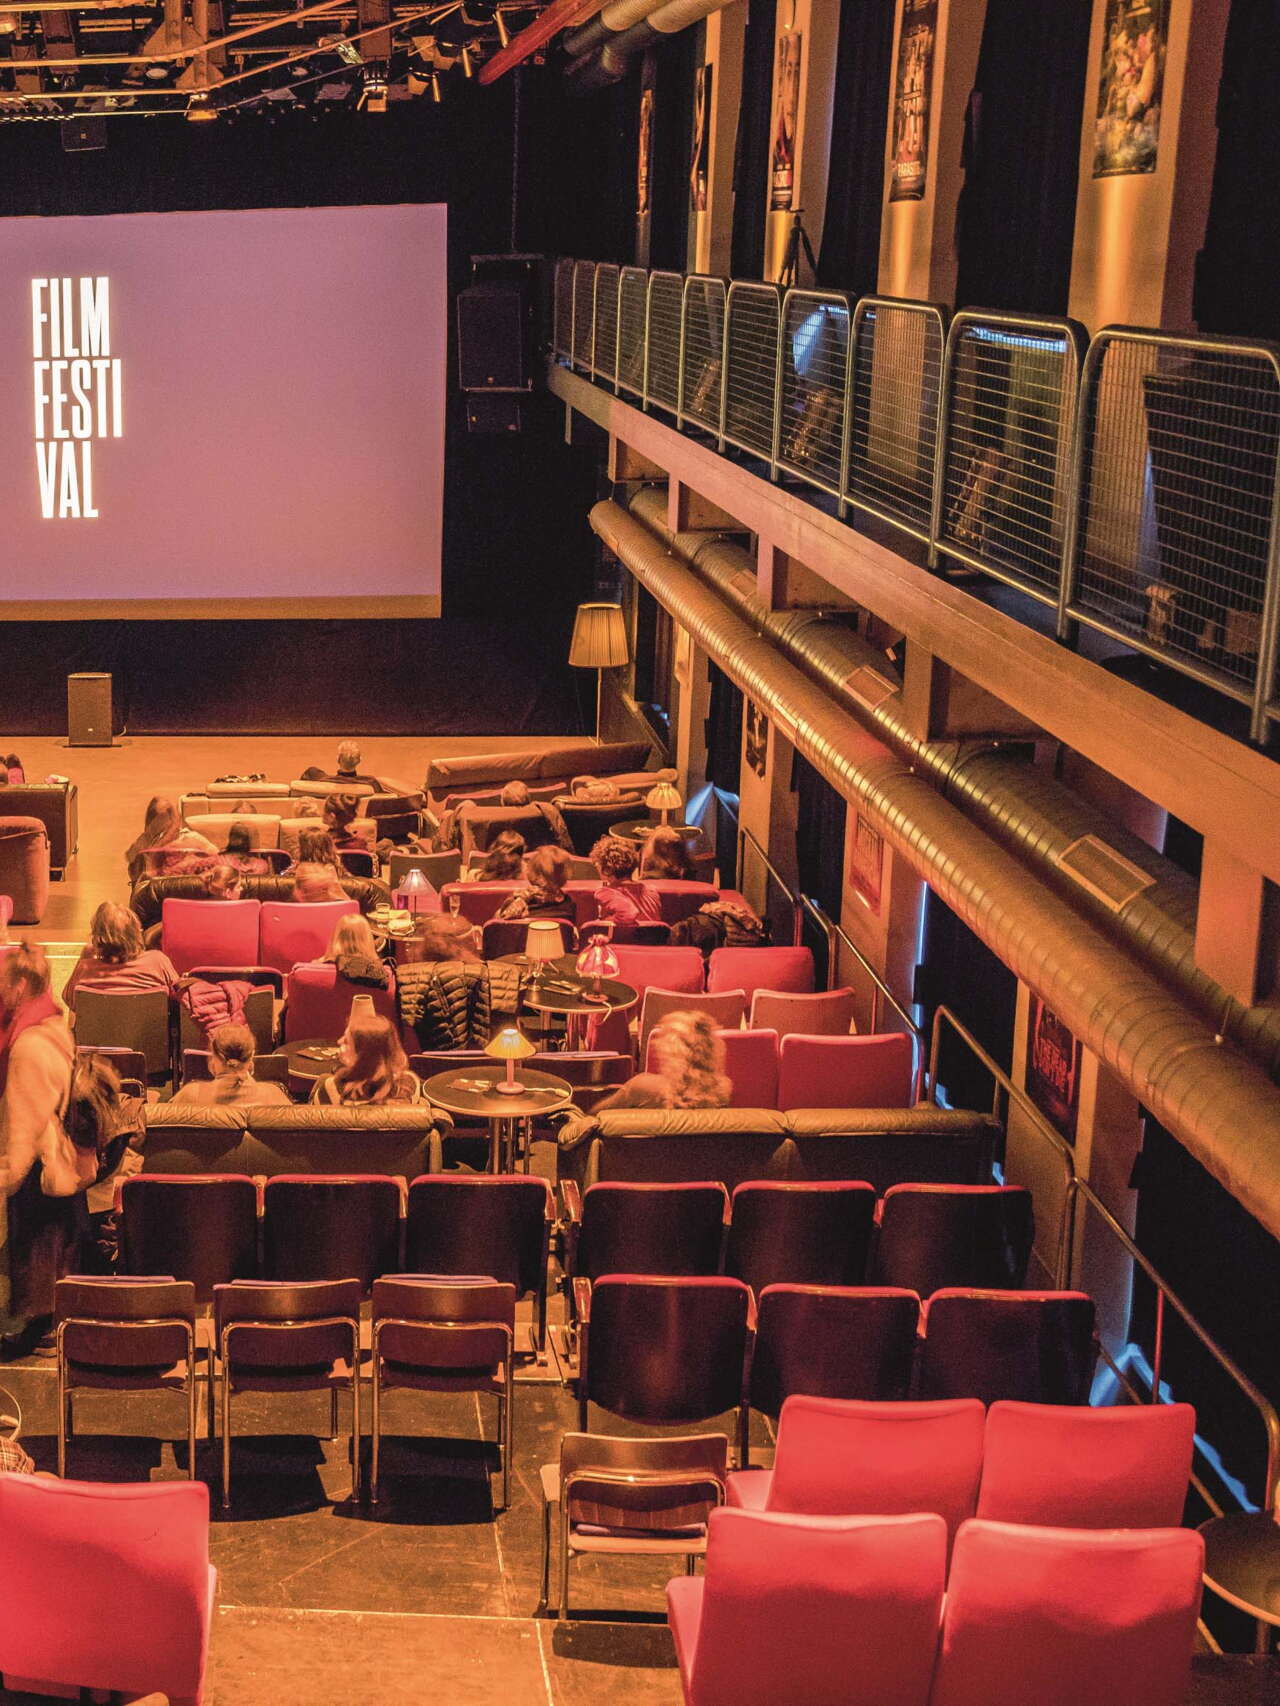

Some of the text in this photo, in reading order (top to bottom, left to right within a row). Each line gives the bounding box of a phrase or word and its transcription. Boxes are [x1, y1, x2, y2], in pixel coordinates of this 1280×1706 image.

[31, 276, 111, 358] FILM
[33, 358, 123, 439] FESTI
[35, 440, 99, 519] VAL
